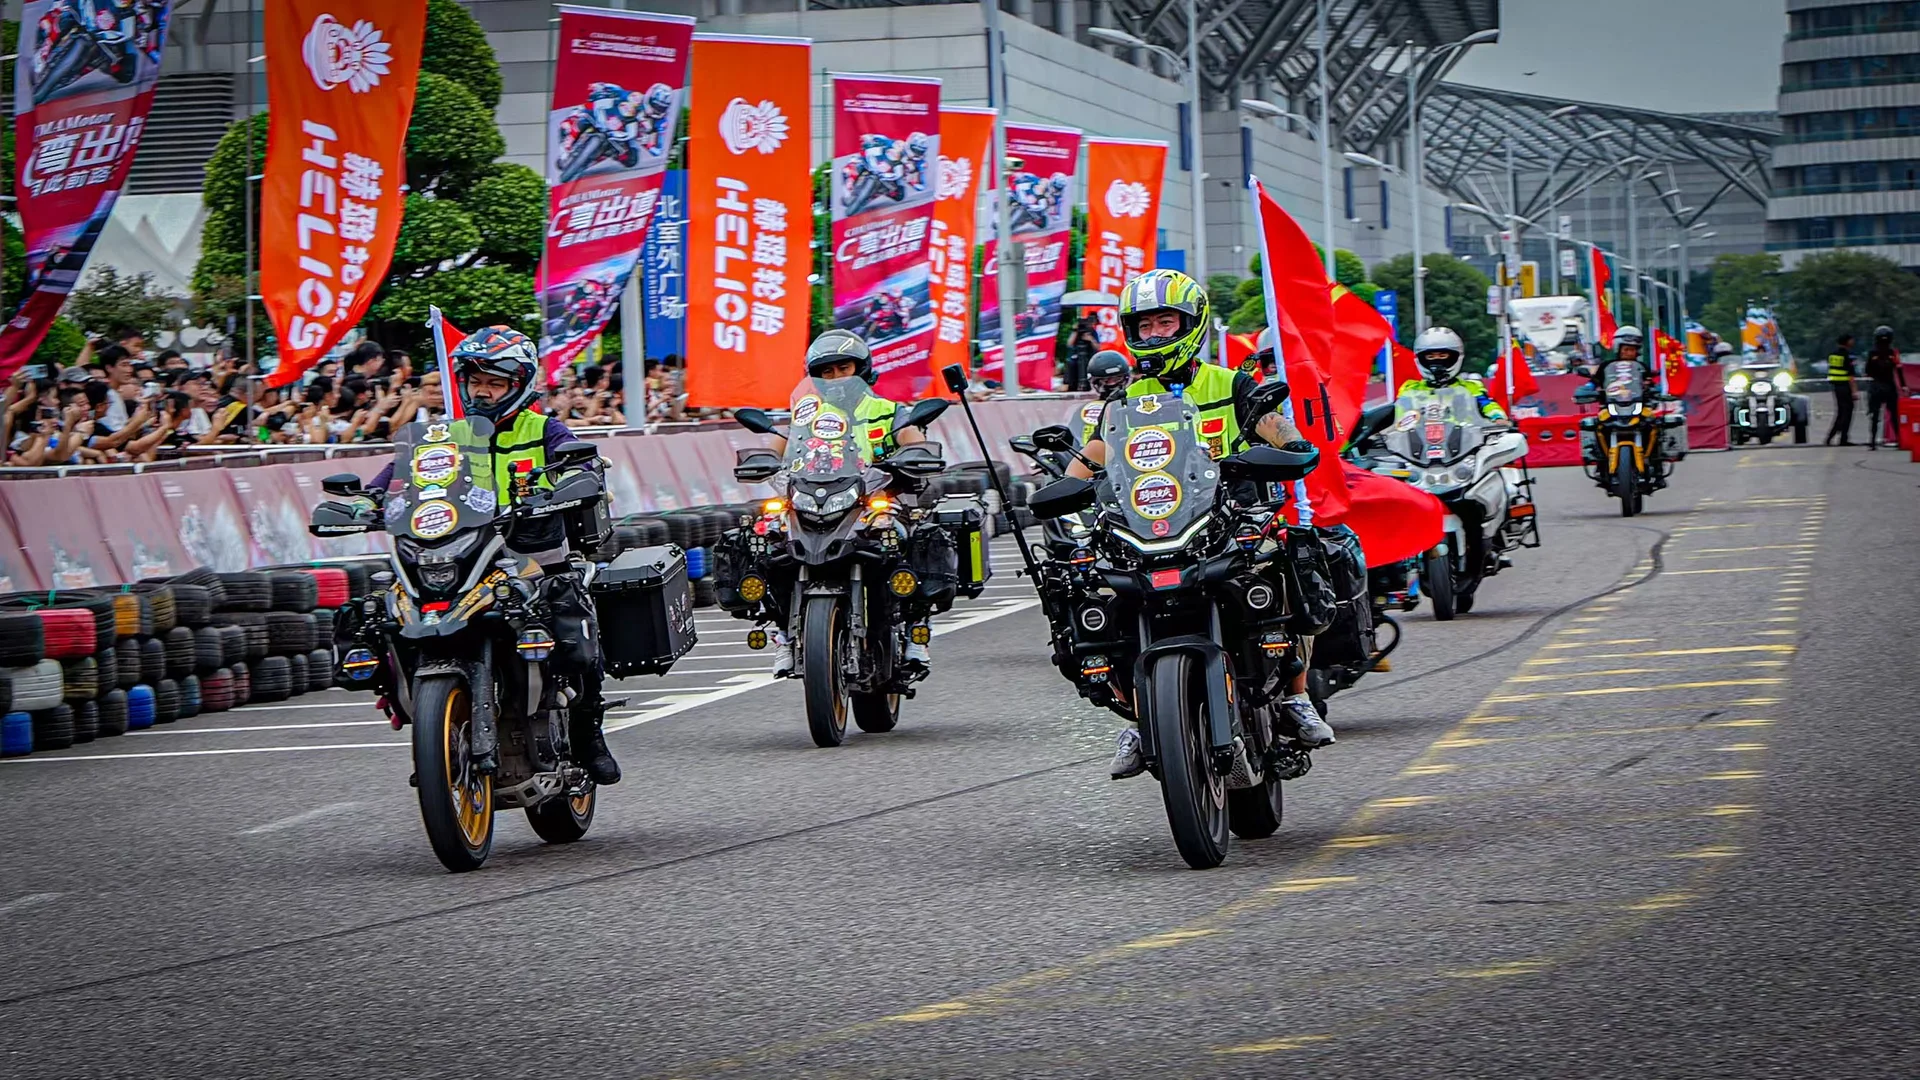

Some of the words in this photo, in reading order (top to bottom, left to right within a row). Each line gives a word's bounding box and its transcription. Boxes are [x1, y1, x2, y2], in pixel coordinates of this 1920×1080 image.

[287, 119, 338, 352] HELIOS
[548, 188, 660, 237] C弯出道
[655, 194, 684, 320] 北室外广场
[713, 176, 749, 353] HELIOS
[750, 197, 789, 336] 赫璐轮胎
[1095, 231, 1123, 343] HELOS
